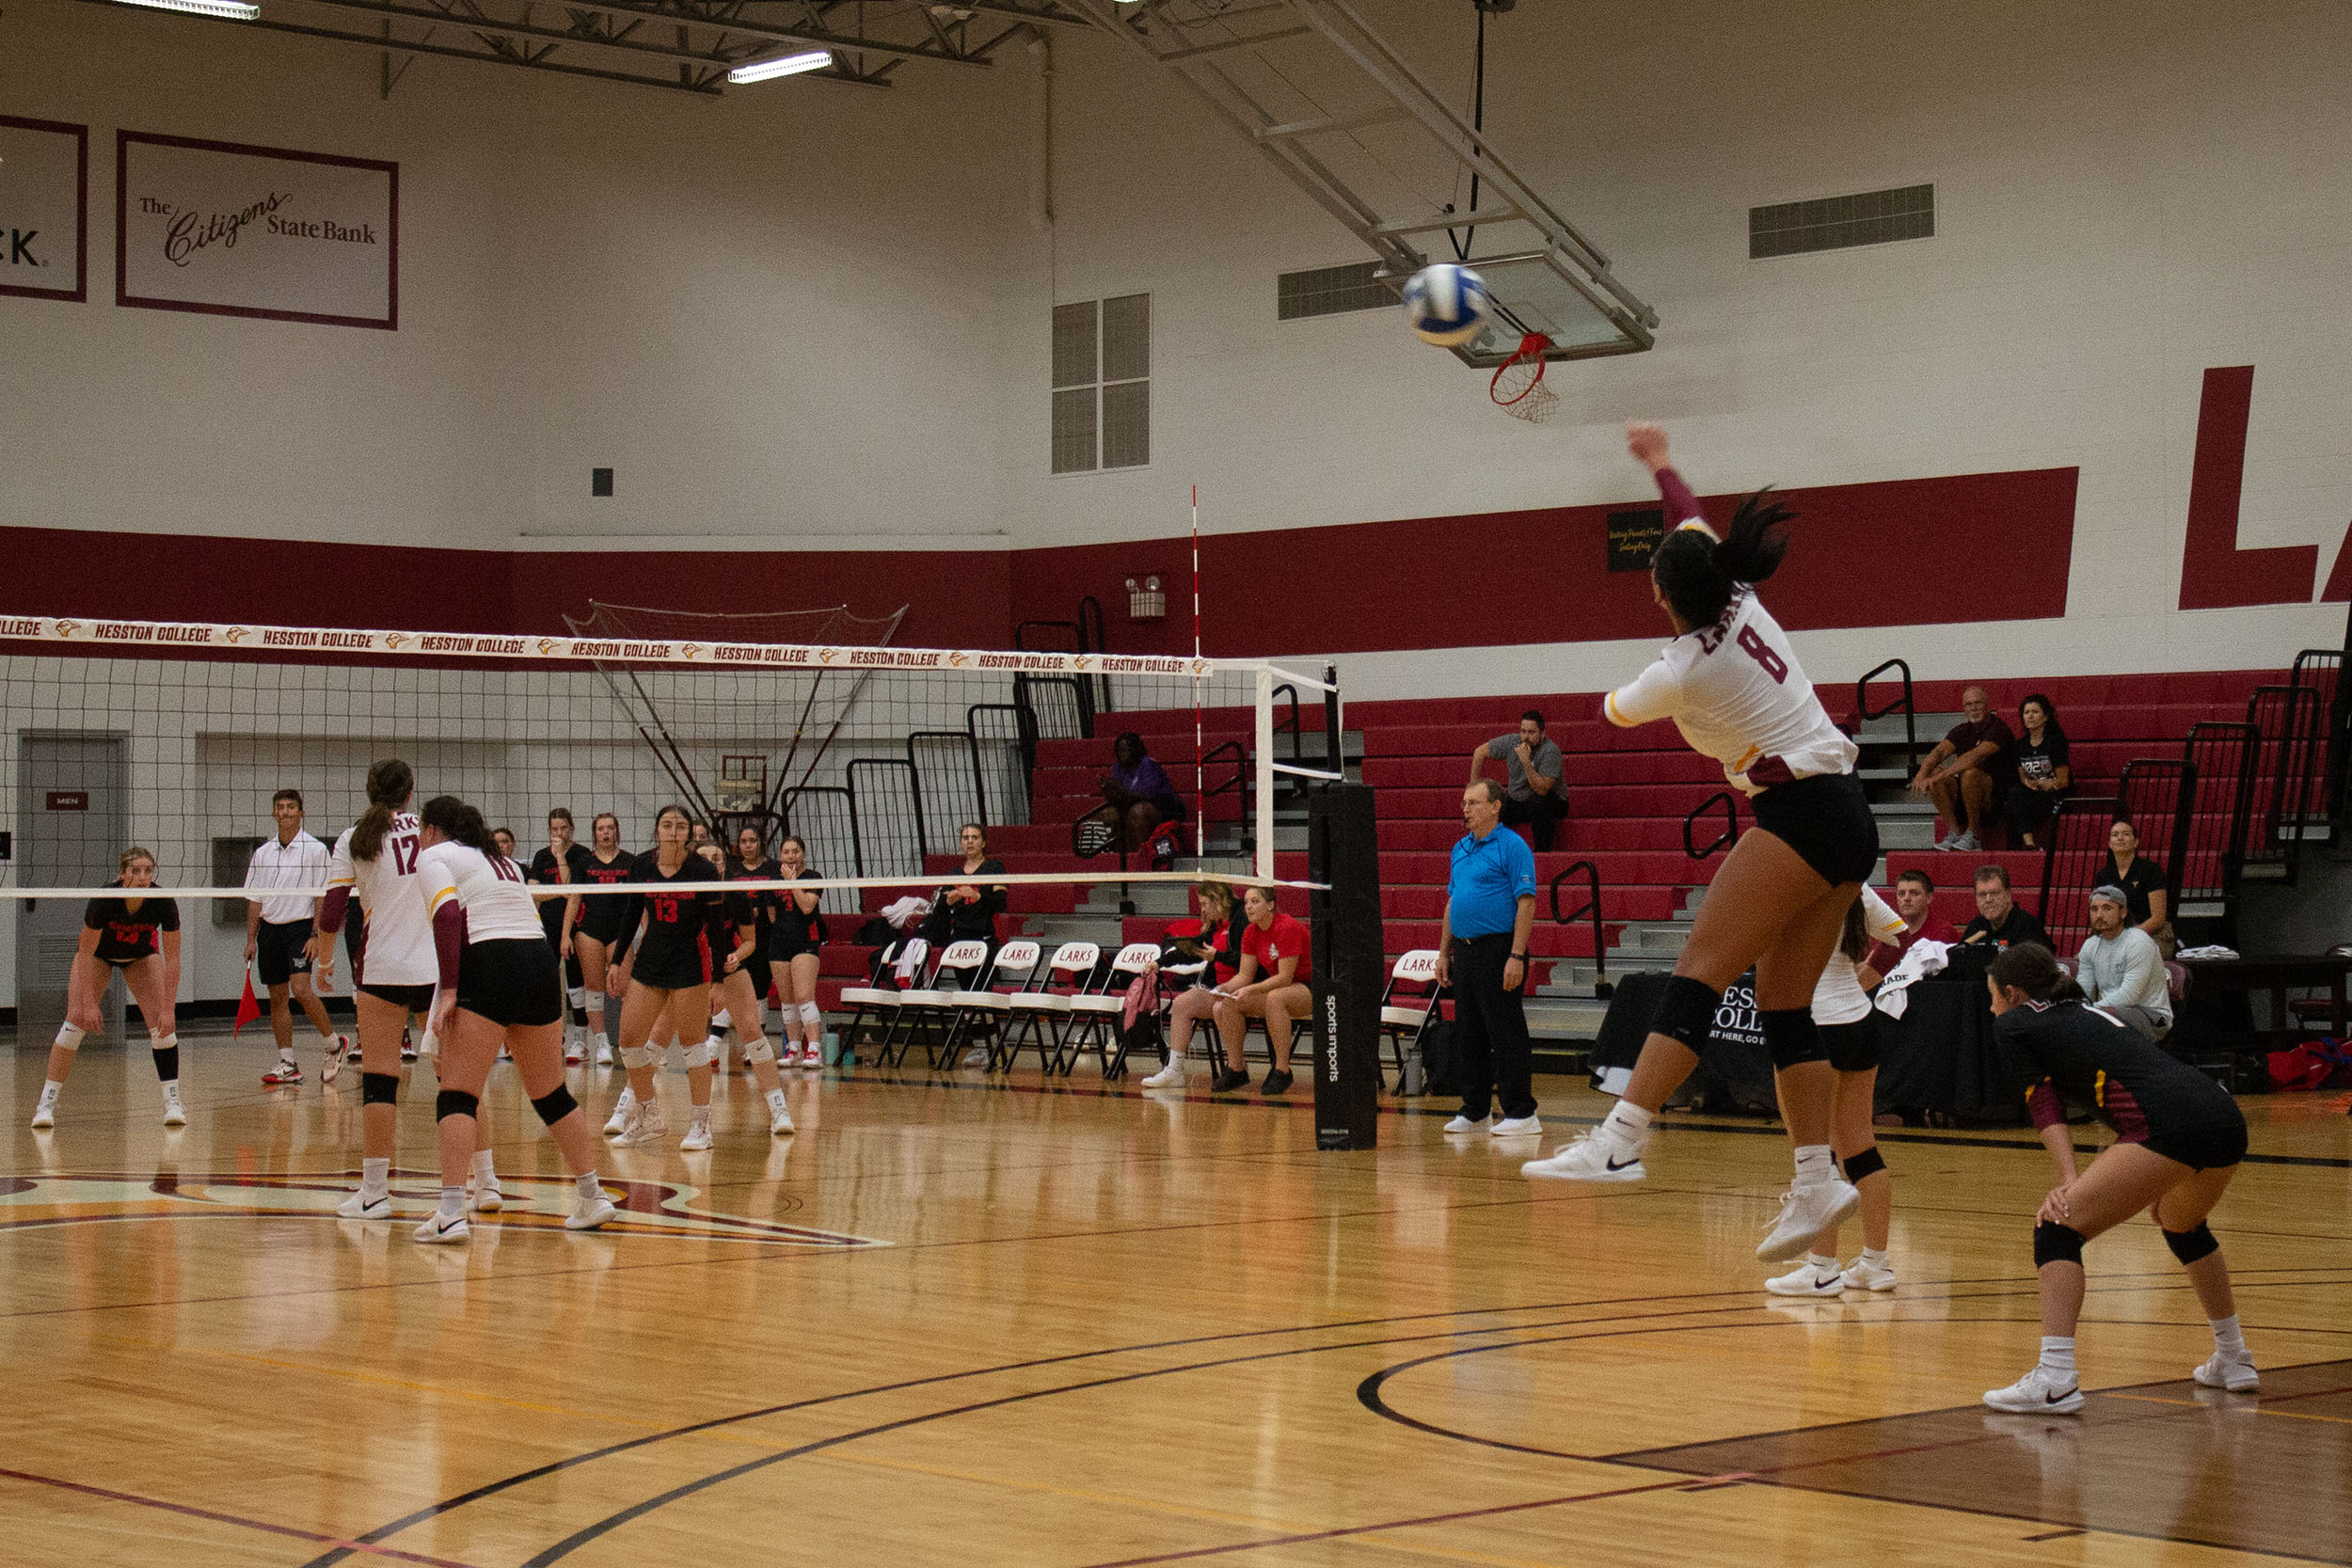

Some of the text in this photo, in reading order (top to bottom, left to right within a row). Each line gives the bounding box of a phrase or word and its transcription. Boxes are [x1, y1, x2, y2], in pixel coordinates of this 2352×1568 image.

[140, 197, 171, 216] The
[165, 192, 293, 267] Citizens
[267, 214, 376, 245] State Bank
[2178, 365, 2352, 611] L
[0, 621, 41, 636] LLEGE
[95, 625, 212, 642] HESSTON COLLEGE
[263, 631, 373, 648] HESSTON COLLEGE
[421, 637, 525, 654] HESSTON COLLEGE
[571, 642, 670, 657] HESSTON COLLEGE
[714, 647, 809, 662] HESSTON COLLEGE
[1737, 624, 1788, 685] 8
[850, 652, 940, 666] HESSTON COLLEGE
[978, 655, 1064, 669] HESSTON COLLEGE
[1102, 658, 1184, 673] HESSTON COLLEGE
[391, 834, 421, 876] 12
[655, 898, 677, 923] 13
[948, 946, 981, 959] LARKS
[1002, 948, 1033, 960] LARKS
[1058, 949, 1091, 961] LARKS
[1121, 951, 1154, 964] LARKS
[1326, 995, 1340, 1082] sports imports
[1746, 1035, 1758, 1044] GO
